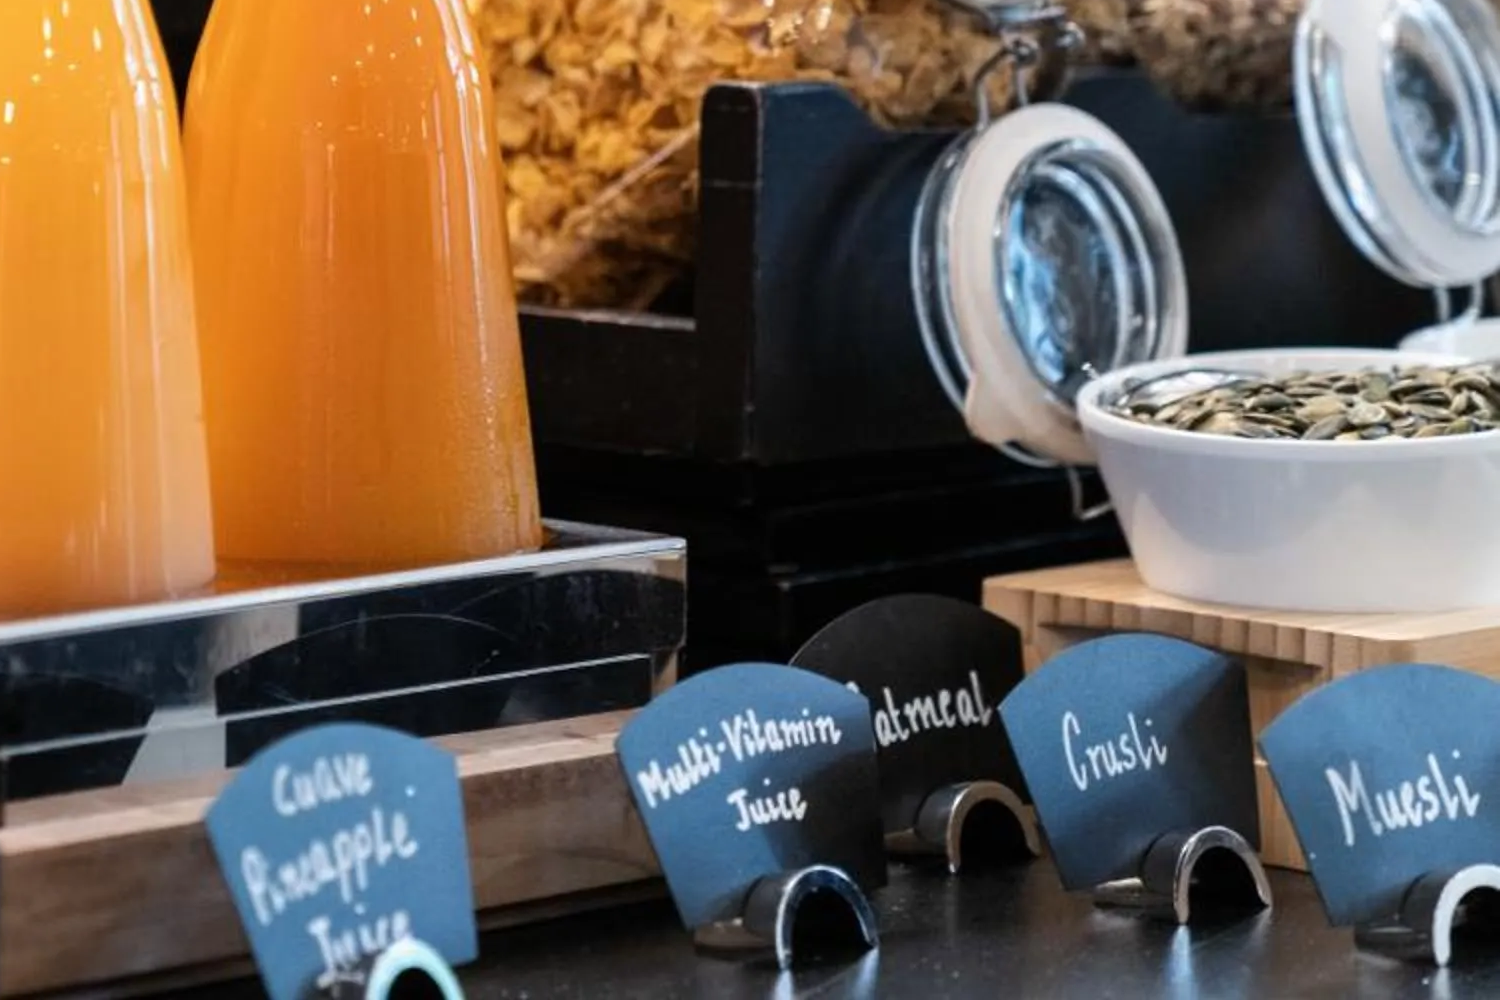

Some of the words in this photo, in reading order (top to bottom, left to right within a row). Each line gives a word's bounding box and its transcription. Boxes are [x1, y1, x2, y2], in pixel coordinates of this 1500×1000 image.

[845, 670, 993, 747] atmeal
[637, 707, 842, 808] Multi-Vitamin
[1062, 711, 1168, 791] Crusli
[727, 778, 808, 832] Juice
[1325, 749, 1481, 846] Muesli
